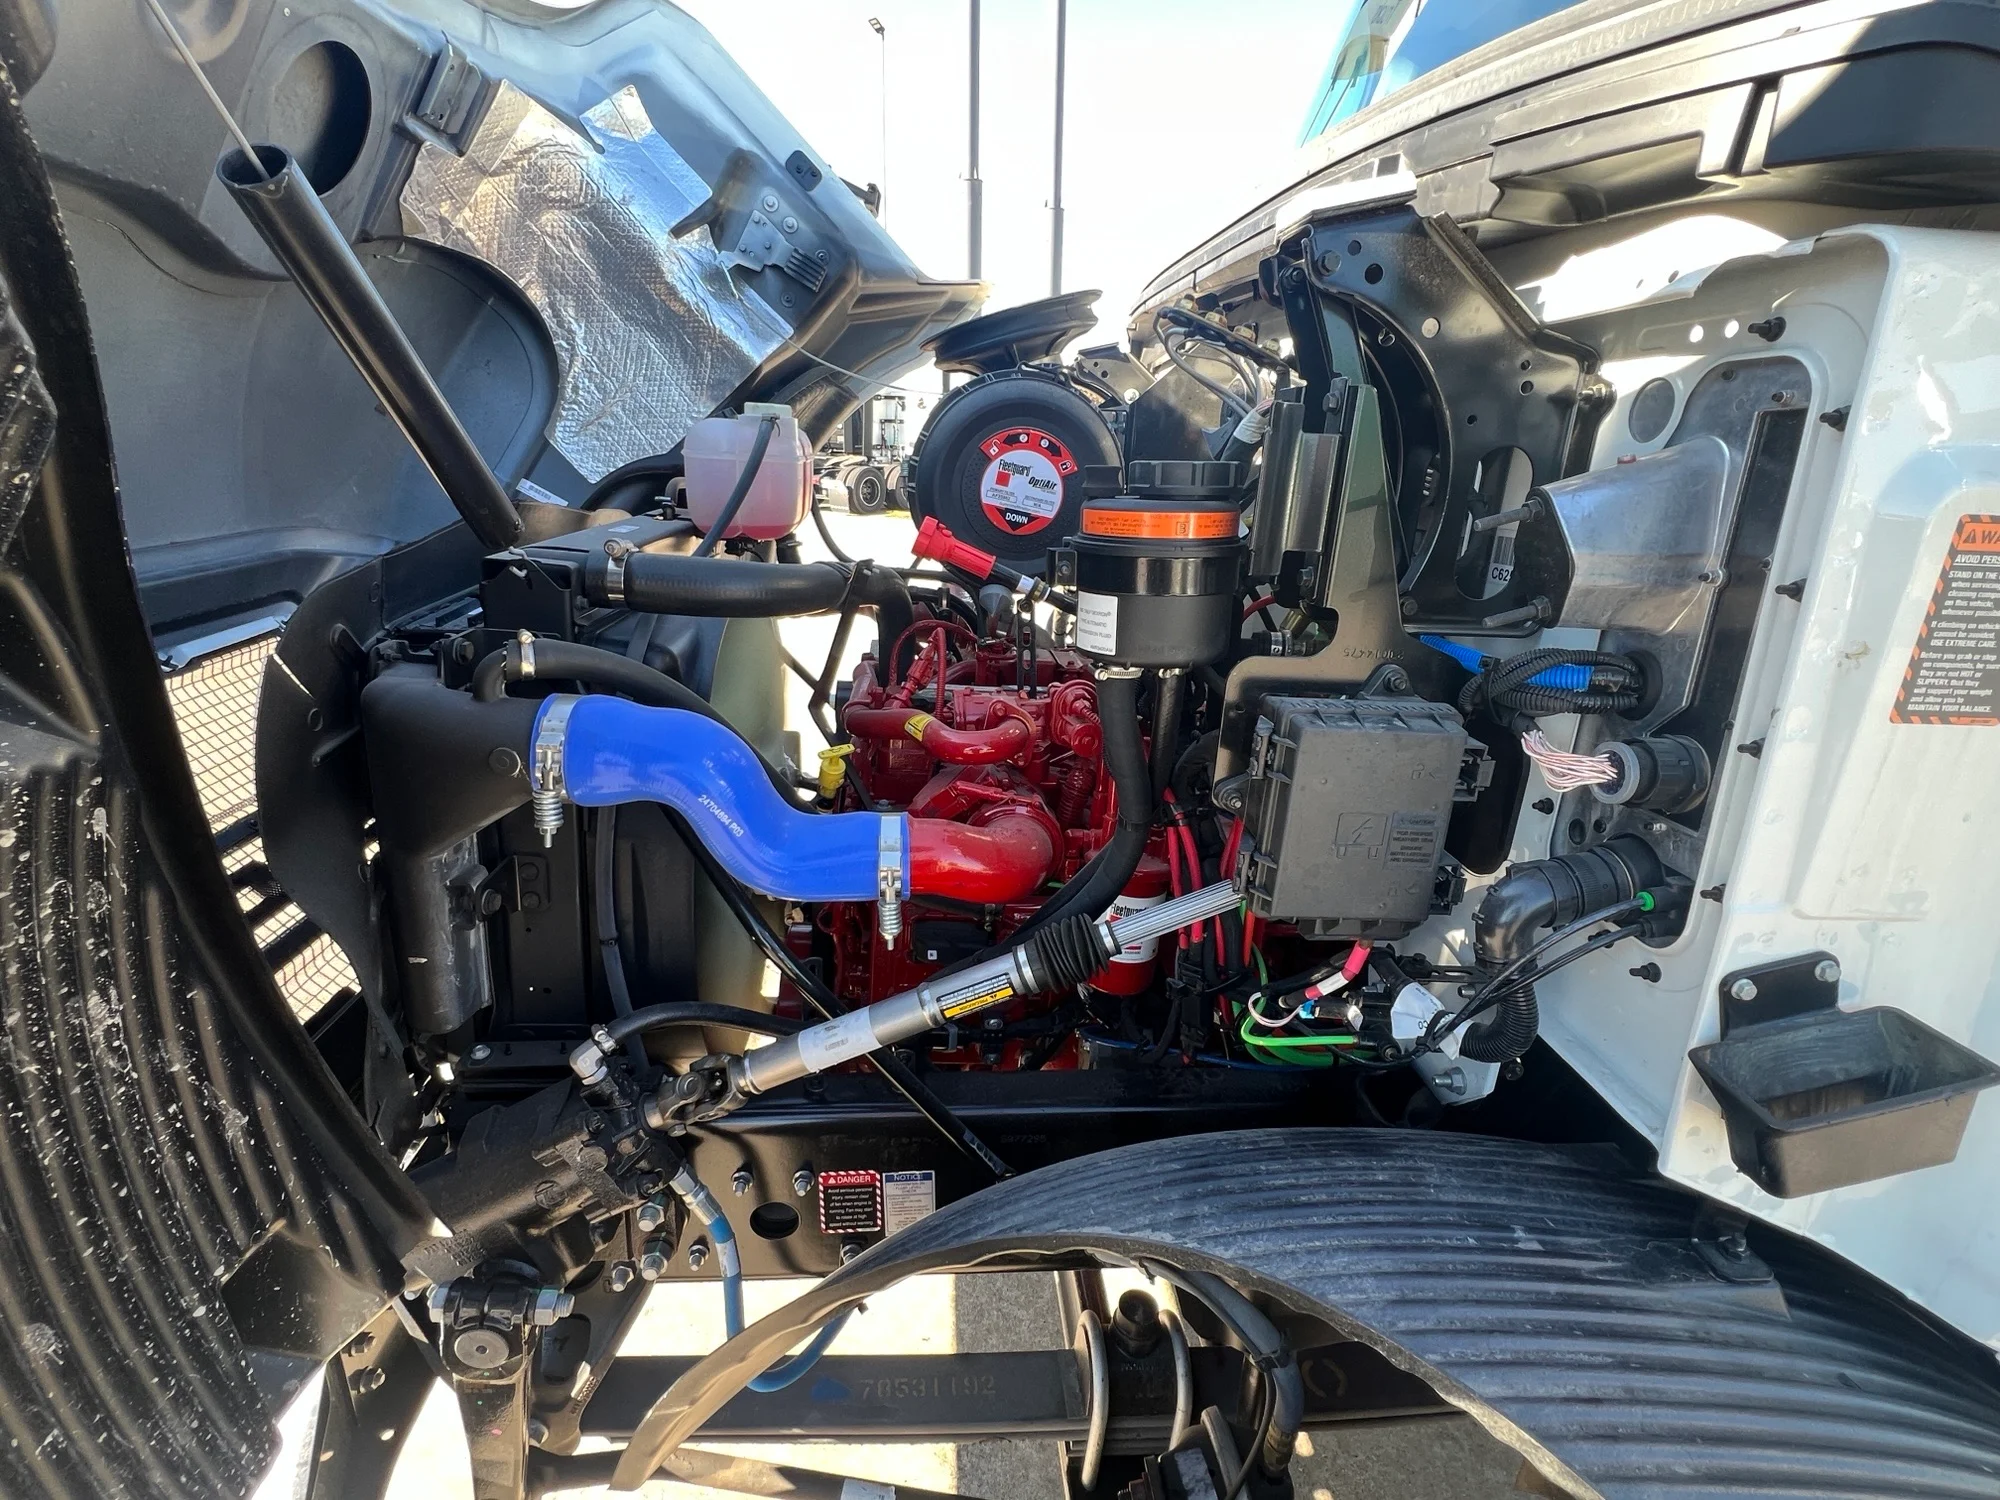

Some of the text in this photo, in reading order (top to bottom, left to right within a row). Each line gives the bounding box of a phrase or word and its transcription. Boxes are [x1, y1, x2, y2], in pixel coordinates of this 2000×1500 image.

[998, 459, 1031, 477] Fleetguard
[1028, 476, 1057, 490] OptiAir
[1006, 513, 1028, 524] DOWN
[1955, 555, 1980, 563] AVOID
[1492, 567, 1513, 581] C62
[1938, 621, 1966, 630] climbing
[728, 822, 744, 837] P03
